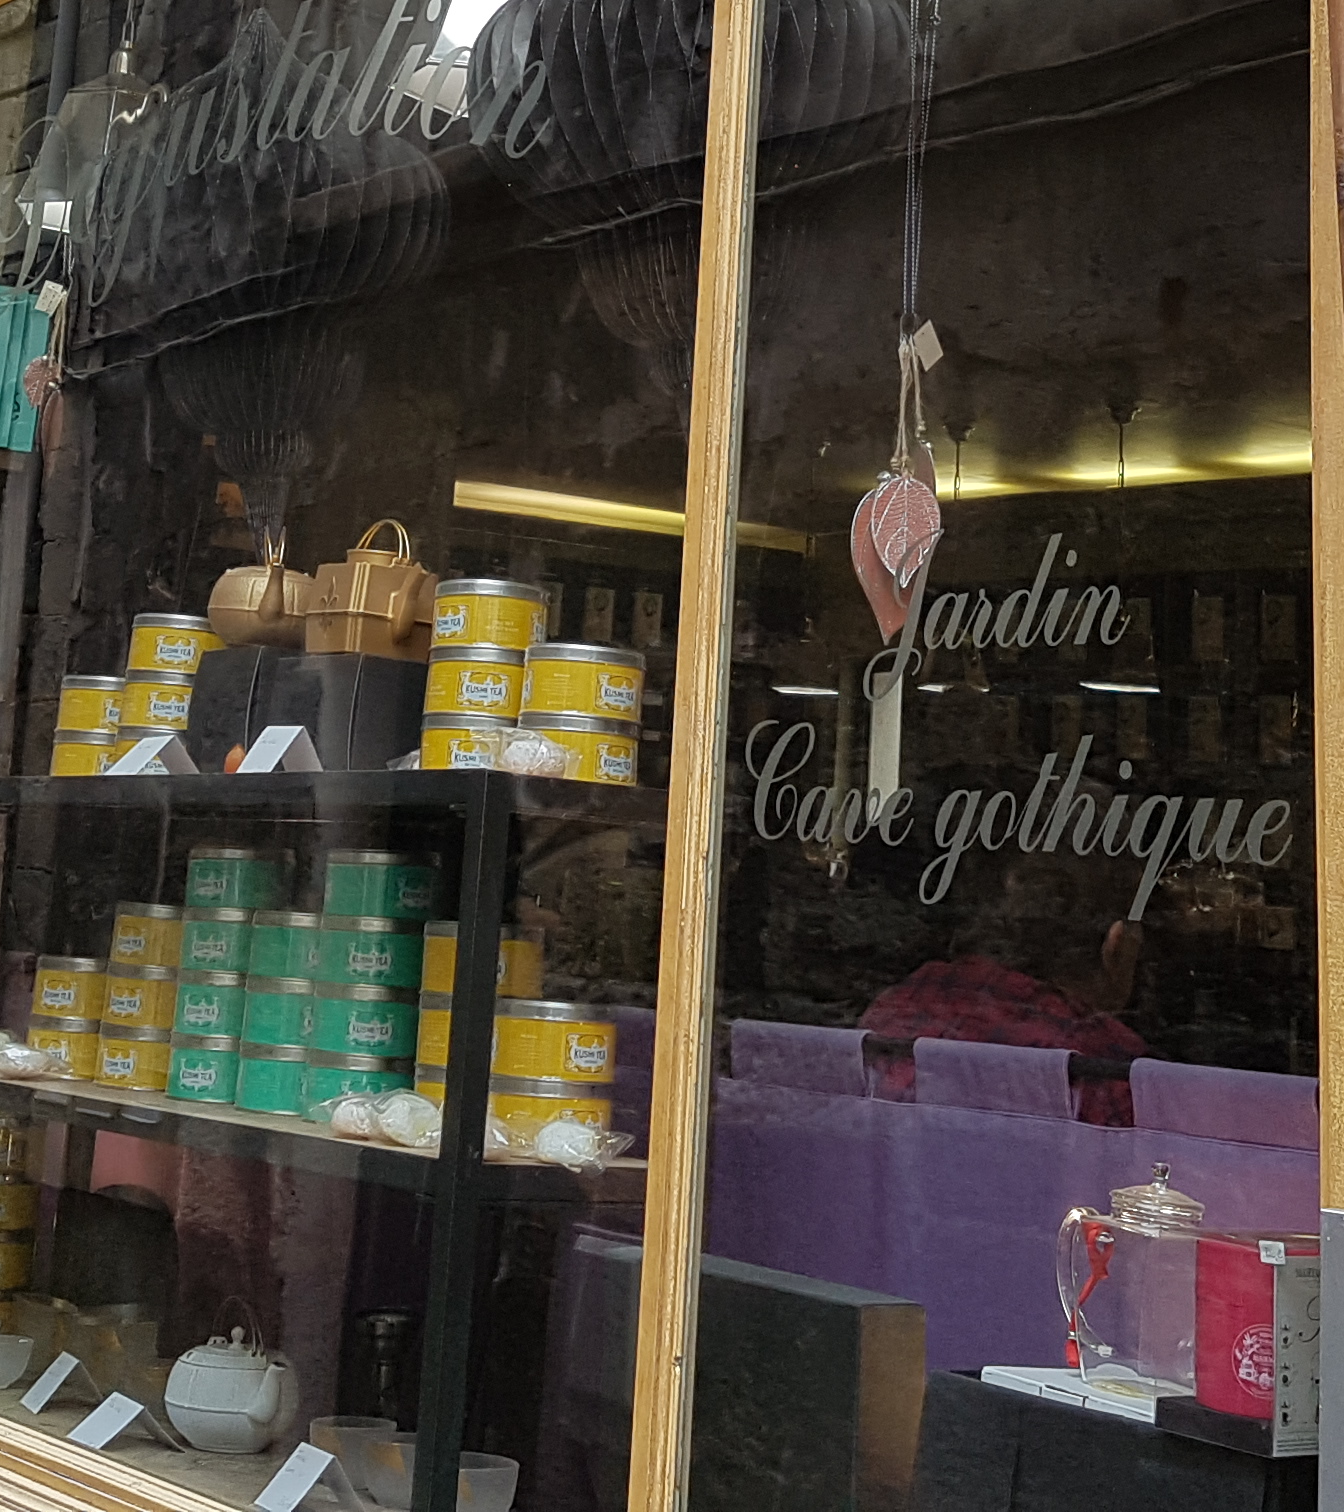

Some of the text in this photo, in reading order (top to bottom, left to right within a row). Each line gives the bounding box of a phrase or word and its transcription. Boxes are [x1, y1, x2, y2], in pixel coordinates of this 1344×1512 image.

[863, 529, 1129, 701] Jardin
[745, 720, 1293, 921] Cave gothique
